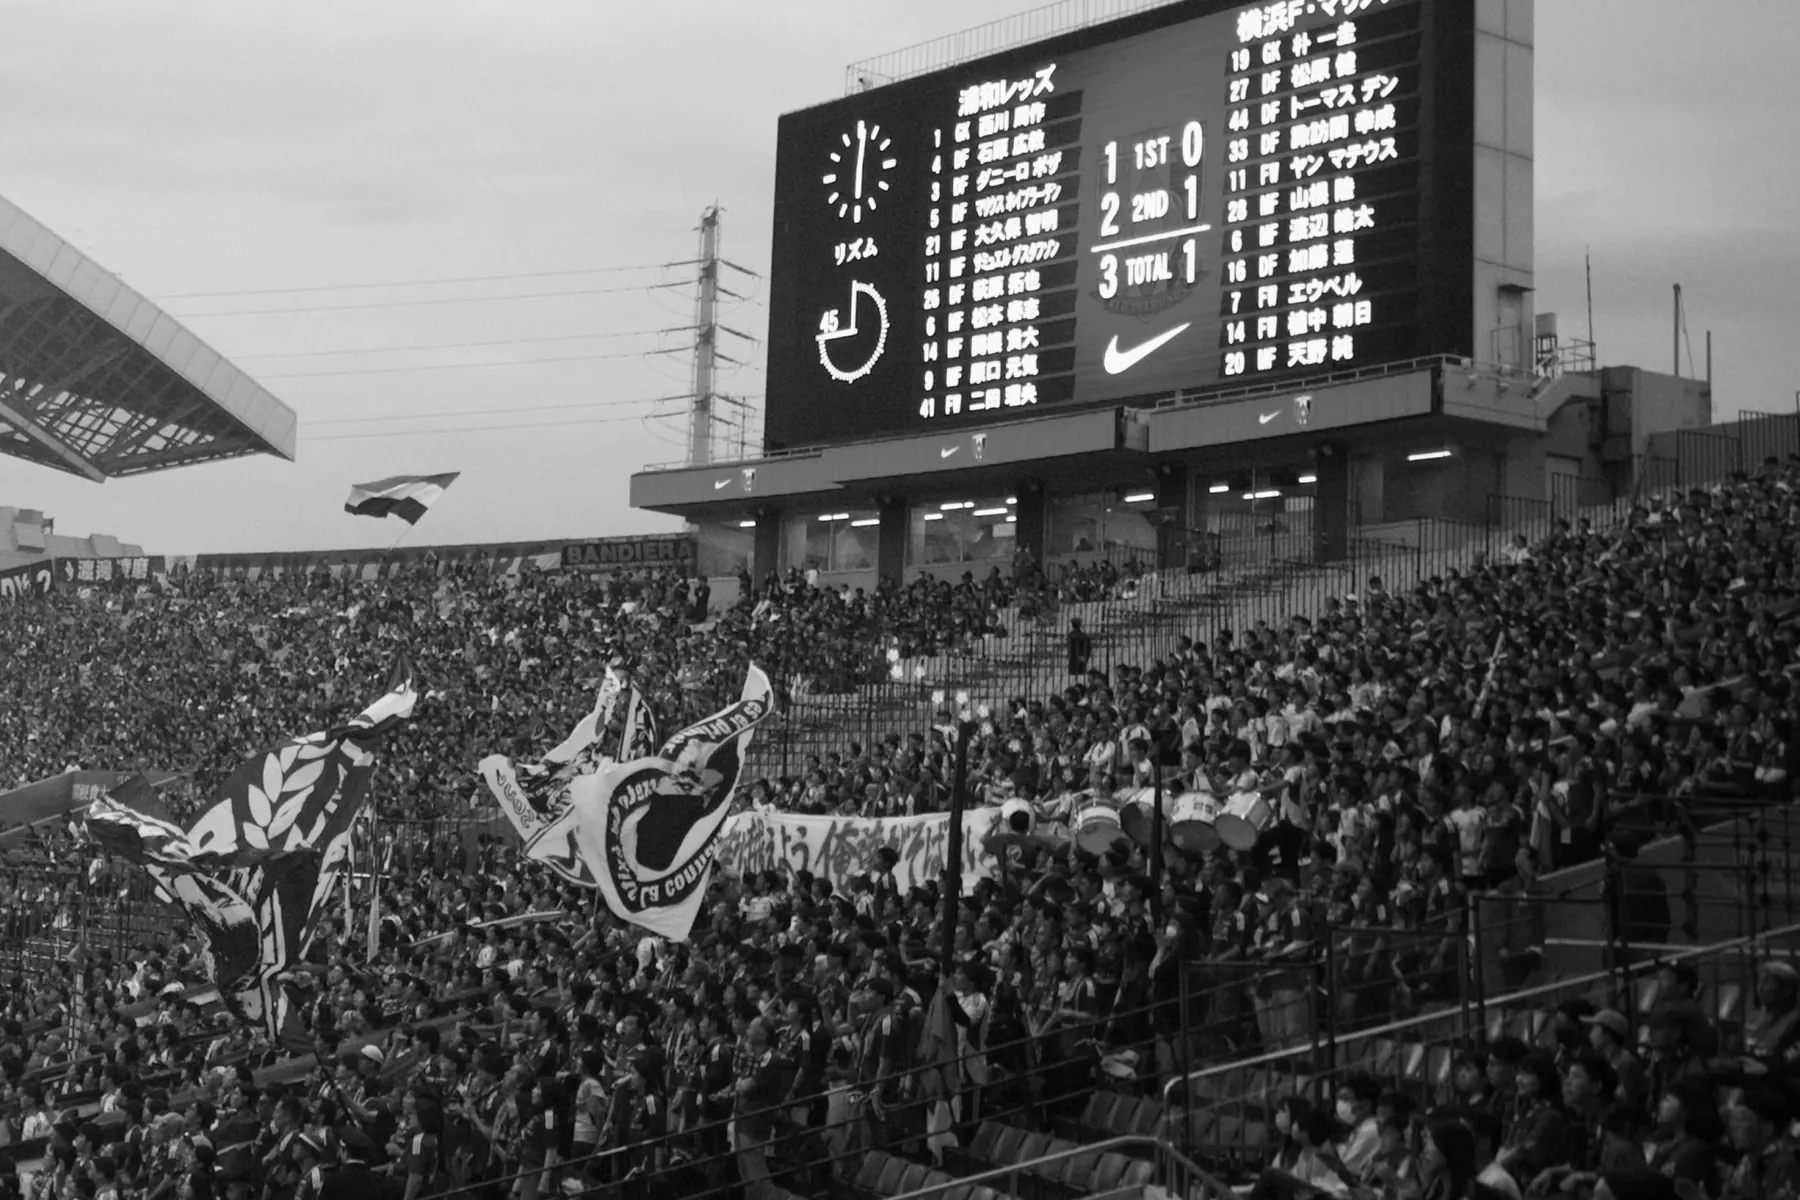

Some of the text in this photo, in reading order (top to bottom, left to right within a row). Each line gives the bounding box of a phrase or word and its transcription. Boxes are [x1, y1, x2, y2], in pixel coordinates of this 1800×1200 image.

[1232, 49, 1249, 71] 19
[1262, 41, 1281, 64] GK
[1230, 78, 1249, 102] 27
[1262, 70, 1281, 94] DF
[1229, 75, 1398, 131] 44 DF トーマス デン
[935, 129, 940, 147] 1
[955, 121, 970, 142] GK
[1229, 139, 1248, 162] 33
[1261, 131, 1280, 155] DF
[932, 156, 941, 173] 4
[954, 148, 970, 169] DF
[1105, 121, 1202, 183] 1 1ST 0
[1230, 138, 1397, 191] 11 FW ヤン マテウス
[931, 182, 939, 201] 3
[953, 175, 968, 196] DF
[977, 162, 1029, 191] ダニーロ
[930, 209, 939, 228] 5
[952, 202, 967, 223] DF
[1101, 175, 1196, 236] 2 2ND 1
[1228, 199, 1247, 222] 28
[926, 235, 940, 255] 21
[975, 217, 1021, 246] 大久保
[1232, 230, 1242, 252] 6
[835, 238, 877, 265] リズム
[926, 262, 939, 282] 11
[1099, 239, 1195, 298] 3 TOTAL 1
[1228, 260, 1246, 282] 16
[1259, 254, 1278, 277] DF
[924, 289, 939, 309] 26
[949, 284, 965, 305] DF
[1231, 273, 1362, 313] 7 FW エウベル
[820, 310, 840, 332] 45
[926, 317, 935, 336] 6
[1227, 321, 1245, 344] 14
[1258, 316, 1277, 339] FW
[923, 342, 937, 362] 14
[1225, 352, 1244, 375] 20
[1288, 339, 1327, 367] 天野
[925, 371, 933, 390] 9
[920, 398, 934, 417] 41
[946, 394, 961, 414] FW
[567, 540, 693, 564] BANDIERA
